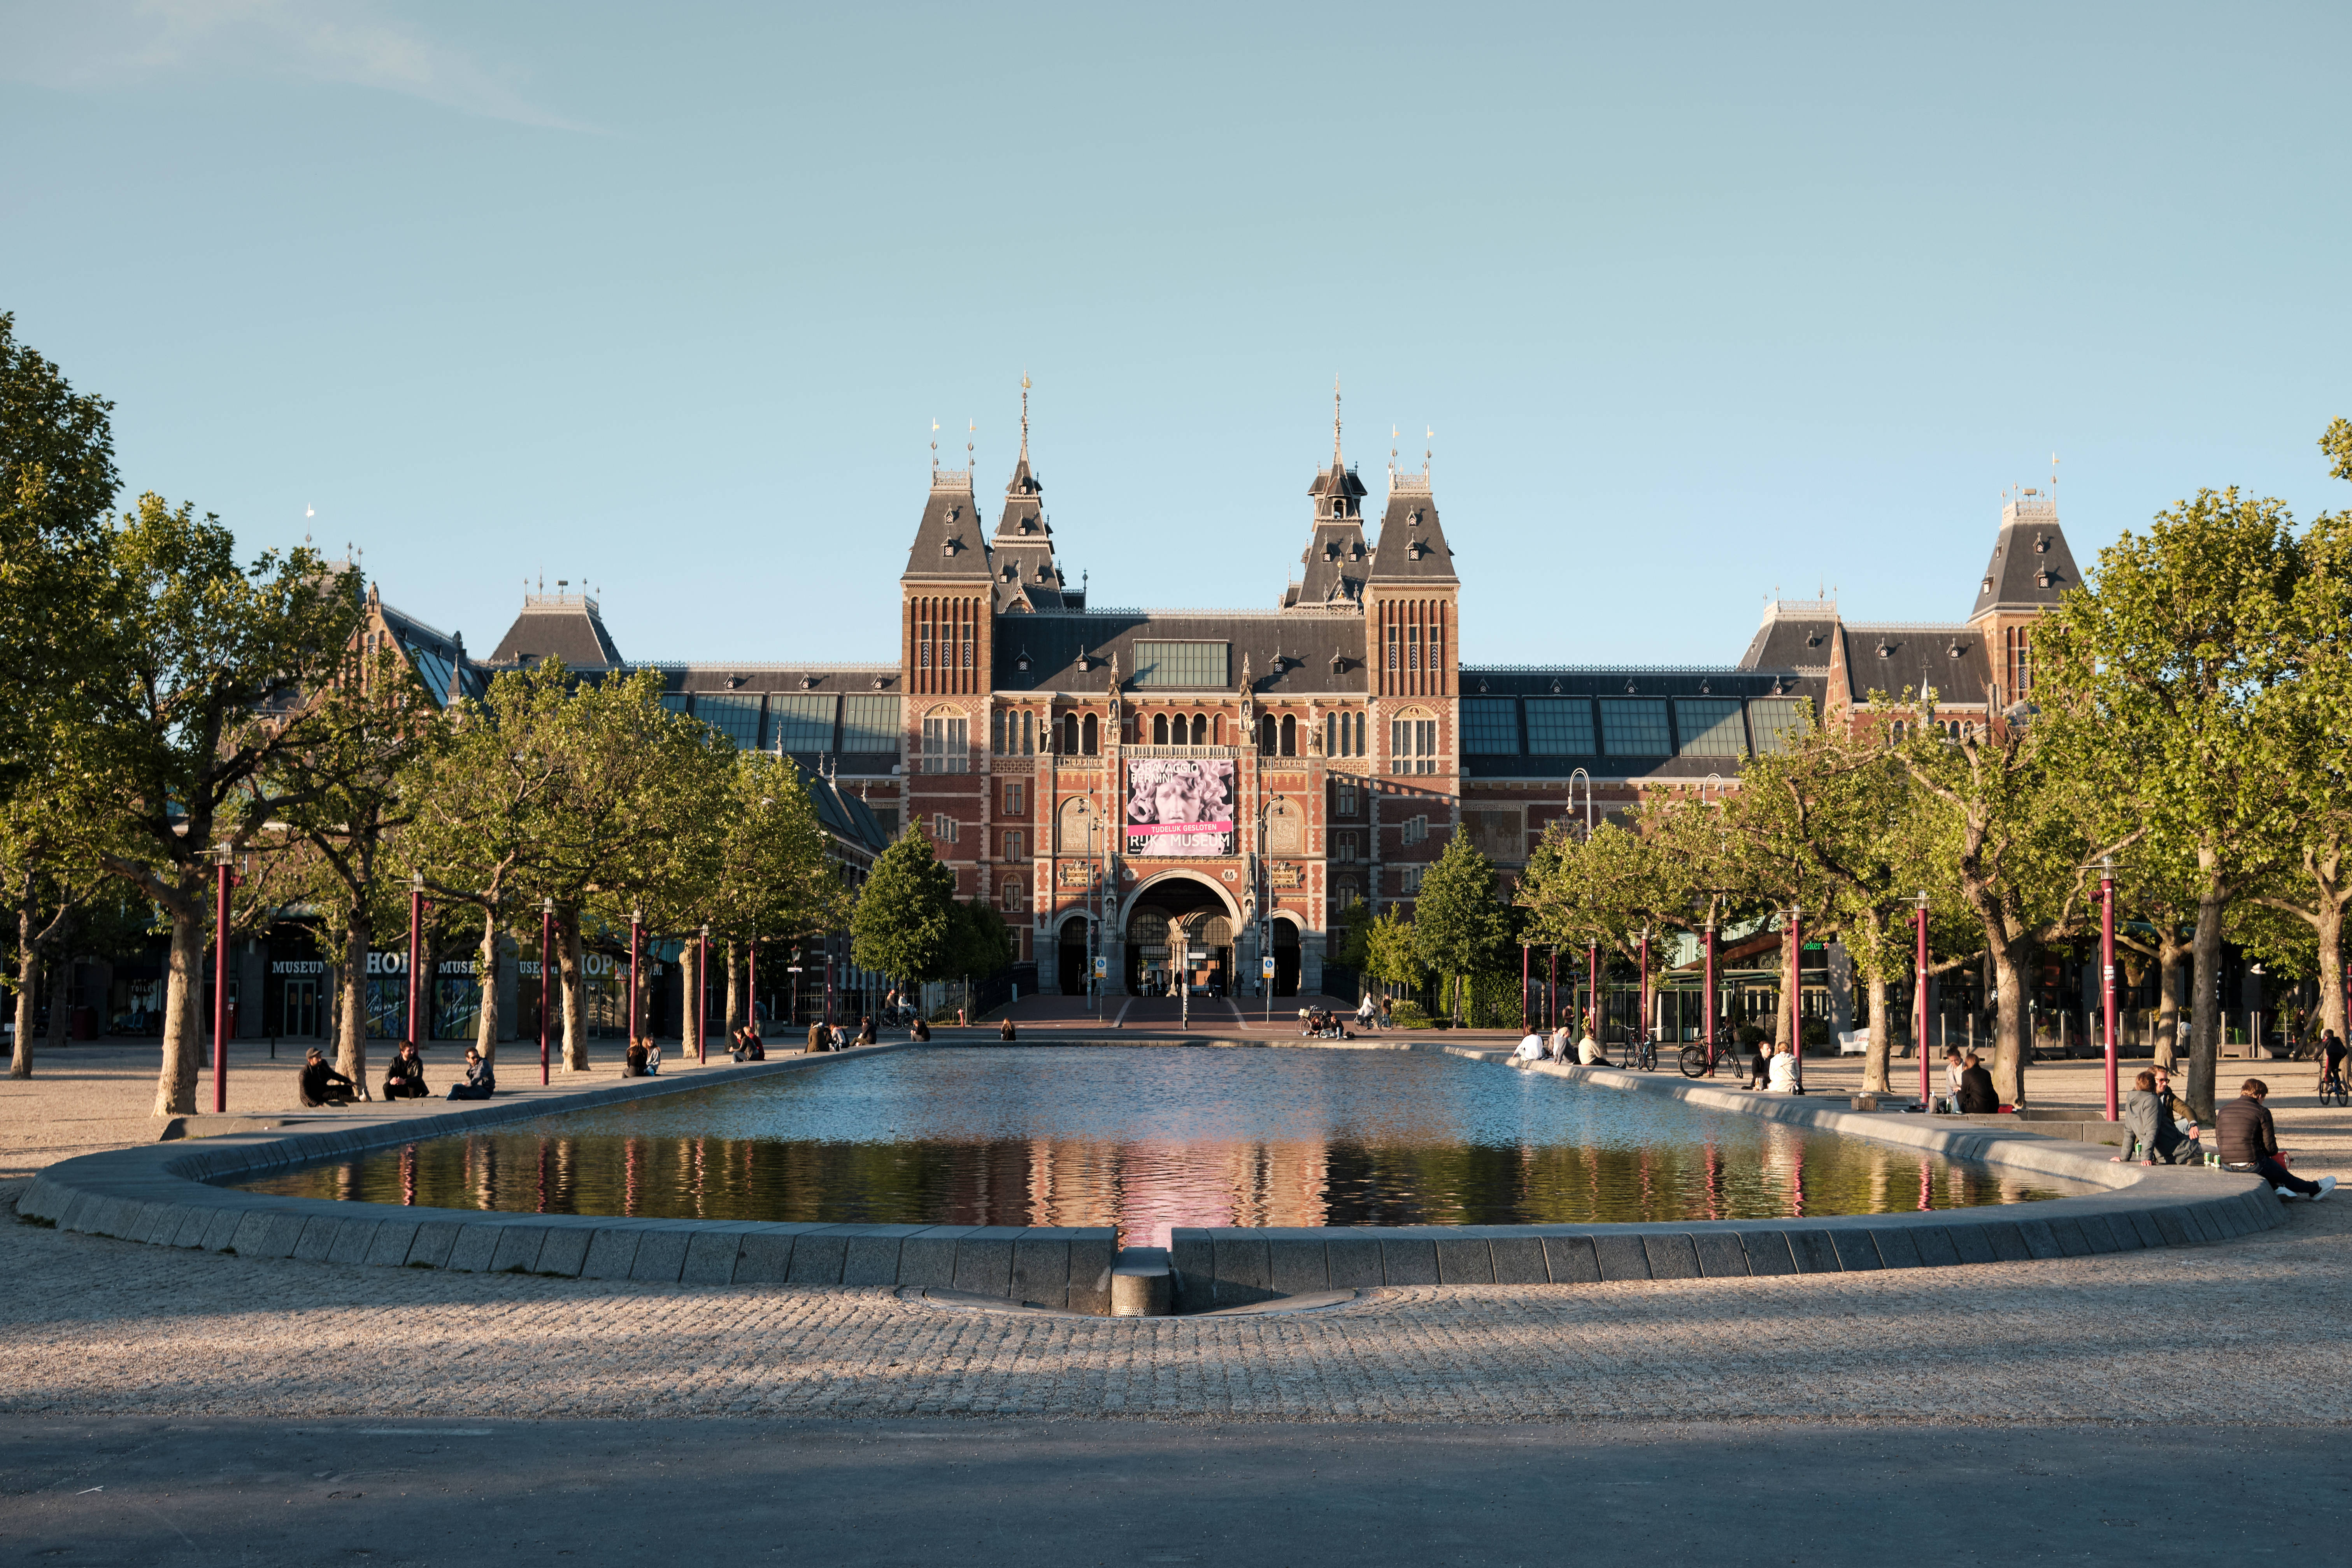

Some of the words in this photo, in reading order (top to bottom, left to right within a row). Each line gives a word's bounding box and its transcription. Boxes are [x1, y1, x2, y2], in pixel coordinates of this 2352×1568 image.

[1130, 763, 1199, 773] CARAVAGGIO
[1131, 773, 1173, 783] BERNINI
[1130, 834, 1166, 847] RIJKS
[1170, 834, 1229, 847] MUSEUM
[438, 961, 477, 973] MUSE
[445, 994, 482, 1017] Vincen
